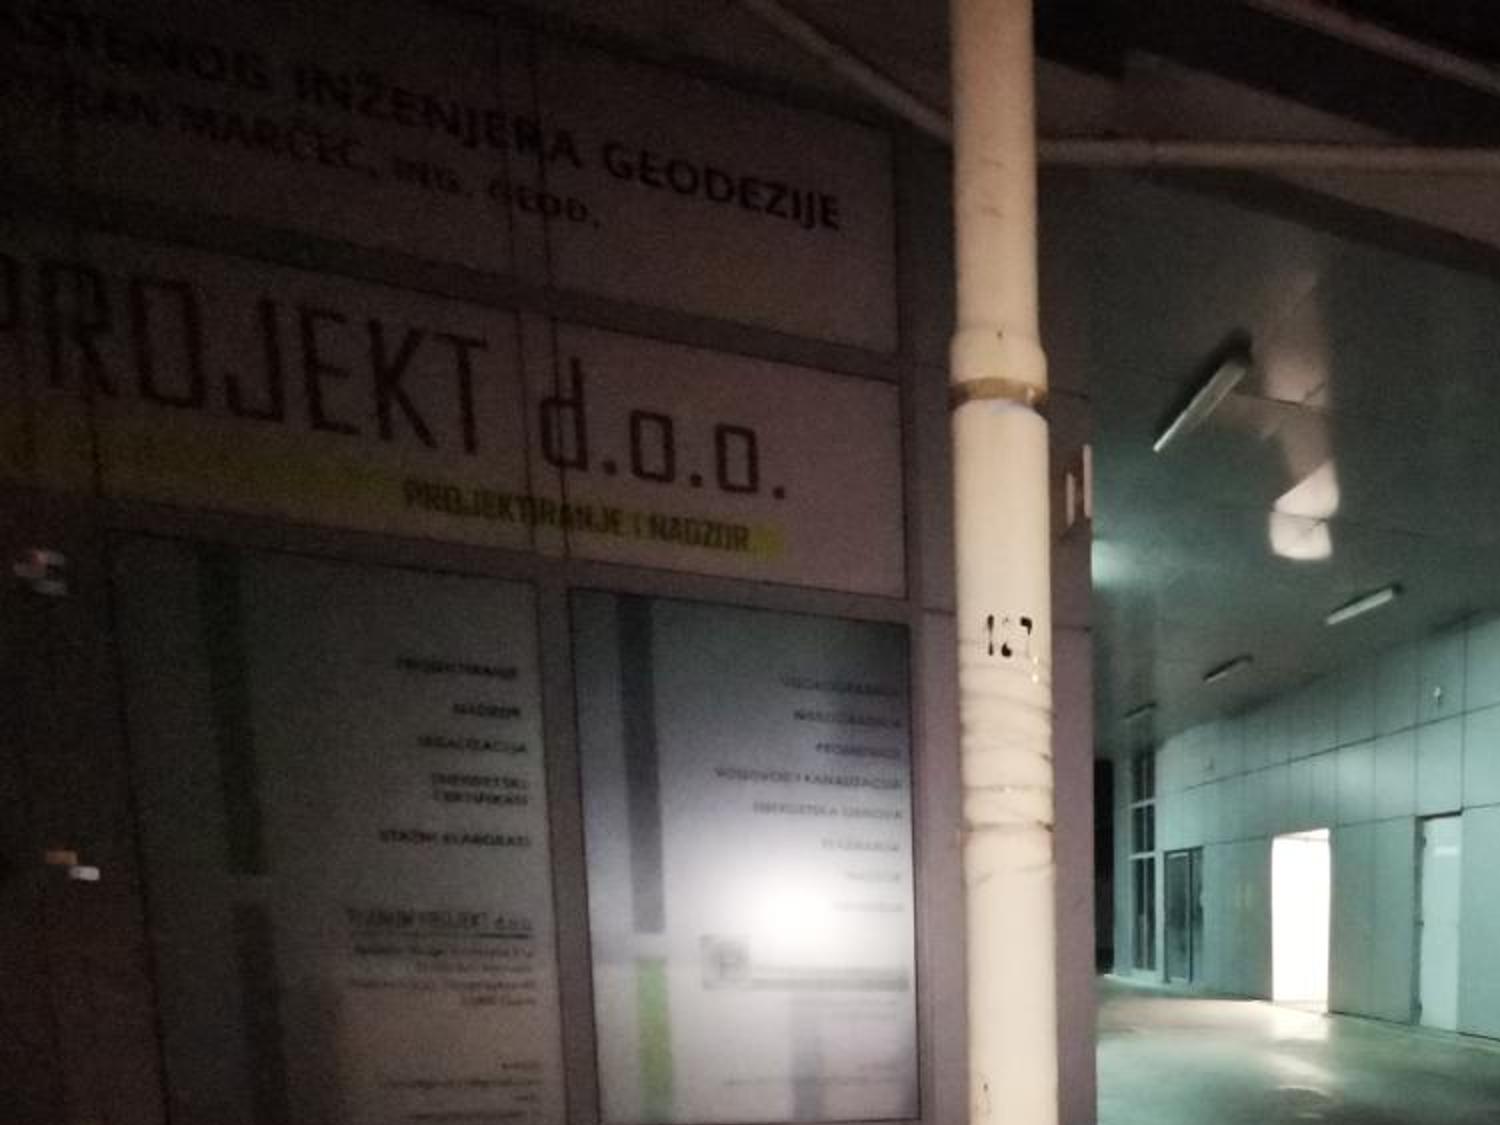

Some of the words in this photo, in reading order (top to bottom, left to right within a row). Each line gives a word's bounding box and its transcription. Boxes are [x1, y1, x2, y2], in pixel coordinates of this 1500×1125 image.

[601, 142, 841, 231] GEODEZIJE
[539, 358, 786, 499] d.o.o.
[402, 479, 623, 536] PROJEKTIRANJE
[649, 514, 750, 551] NADZOR
